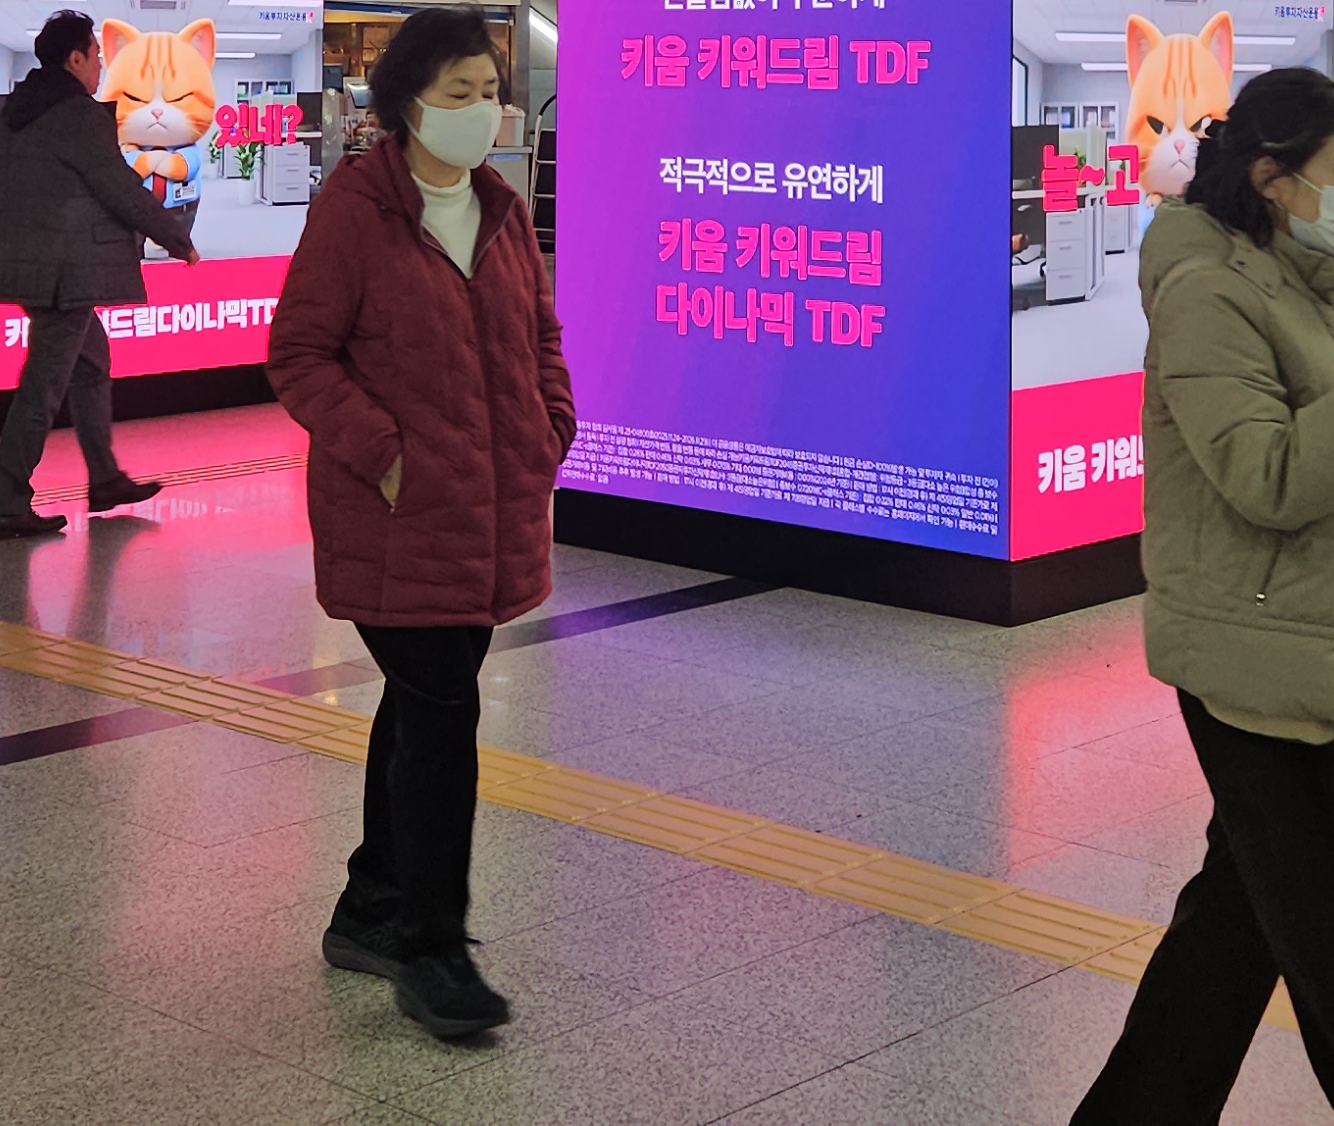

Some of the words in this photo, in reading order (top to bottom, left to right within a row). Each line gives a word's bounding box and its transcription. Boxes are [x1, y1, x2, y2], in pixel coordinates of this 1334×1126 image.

[620, 35, 690, 88] 키움
[696, 35, 840, 91] 키워드림
[849, 39, 932, 86] TDF
[215, 103, 304, 148] 있네?
[659, 156, 777, 195] 적극적으로
[781, 161, 884, 204] 유연하게
[657, 218, 729, 273] 키움
[734, 222, 884, 286] 키워드림
[655, 281, 795, 347] 다이나믹
[804, 298, 886, 347] TDF
[1038, 445, 1087, 493] 키움
